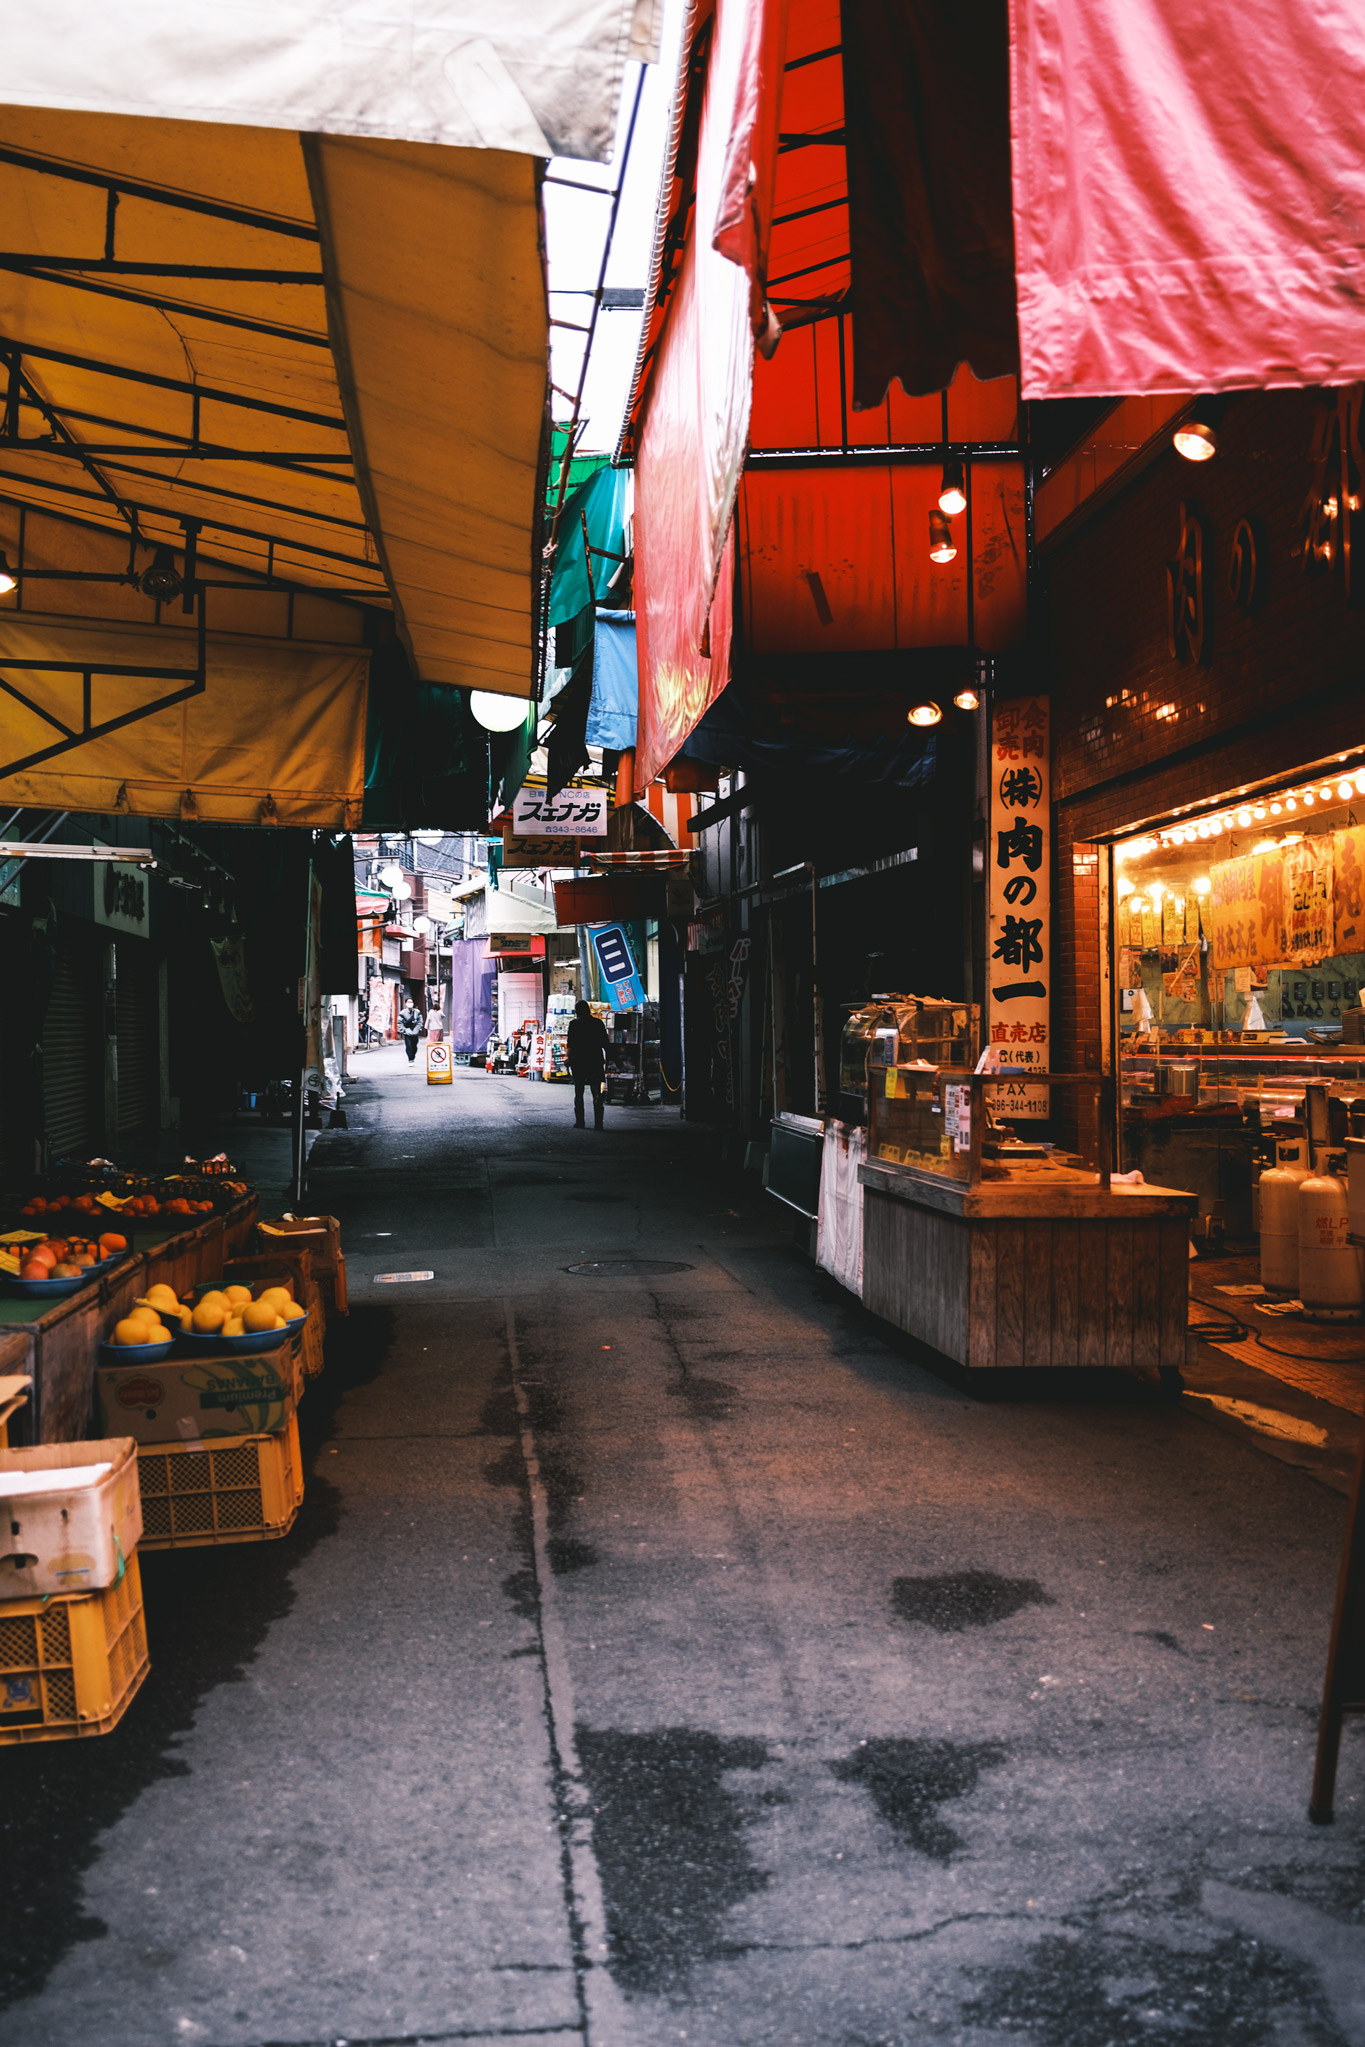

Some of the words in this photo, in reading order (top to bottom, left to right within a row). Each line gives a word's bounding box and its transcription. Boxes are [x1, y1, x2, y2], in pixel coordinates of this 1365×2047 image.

[996, 706, 1021, 761] 卸売
[1021, 700, 1048, 759] 食肉
[552, 825, 598, 833] 343-8646
[991, 1021, 1047, 1043] 直売店
[996, 1083, 1026, 1096] FAX
[217, 1390, 276, 1404] Premium
